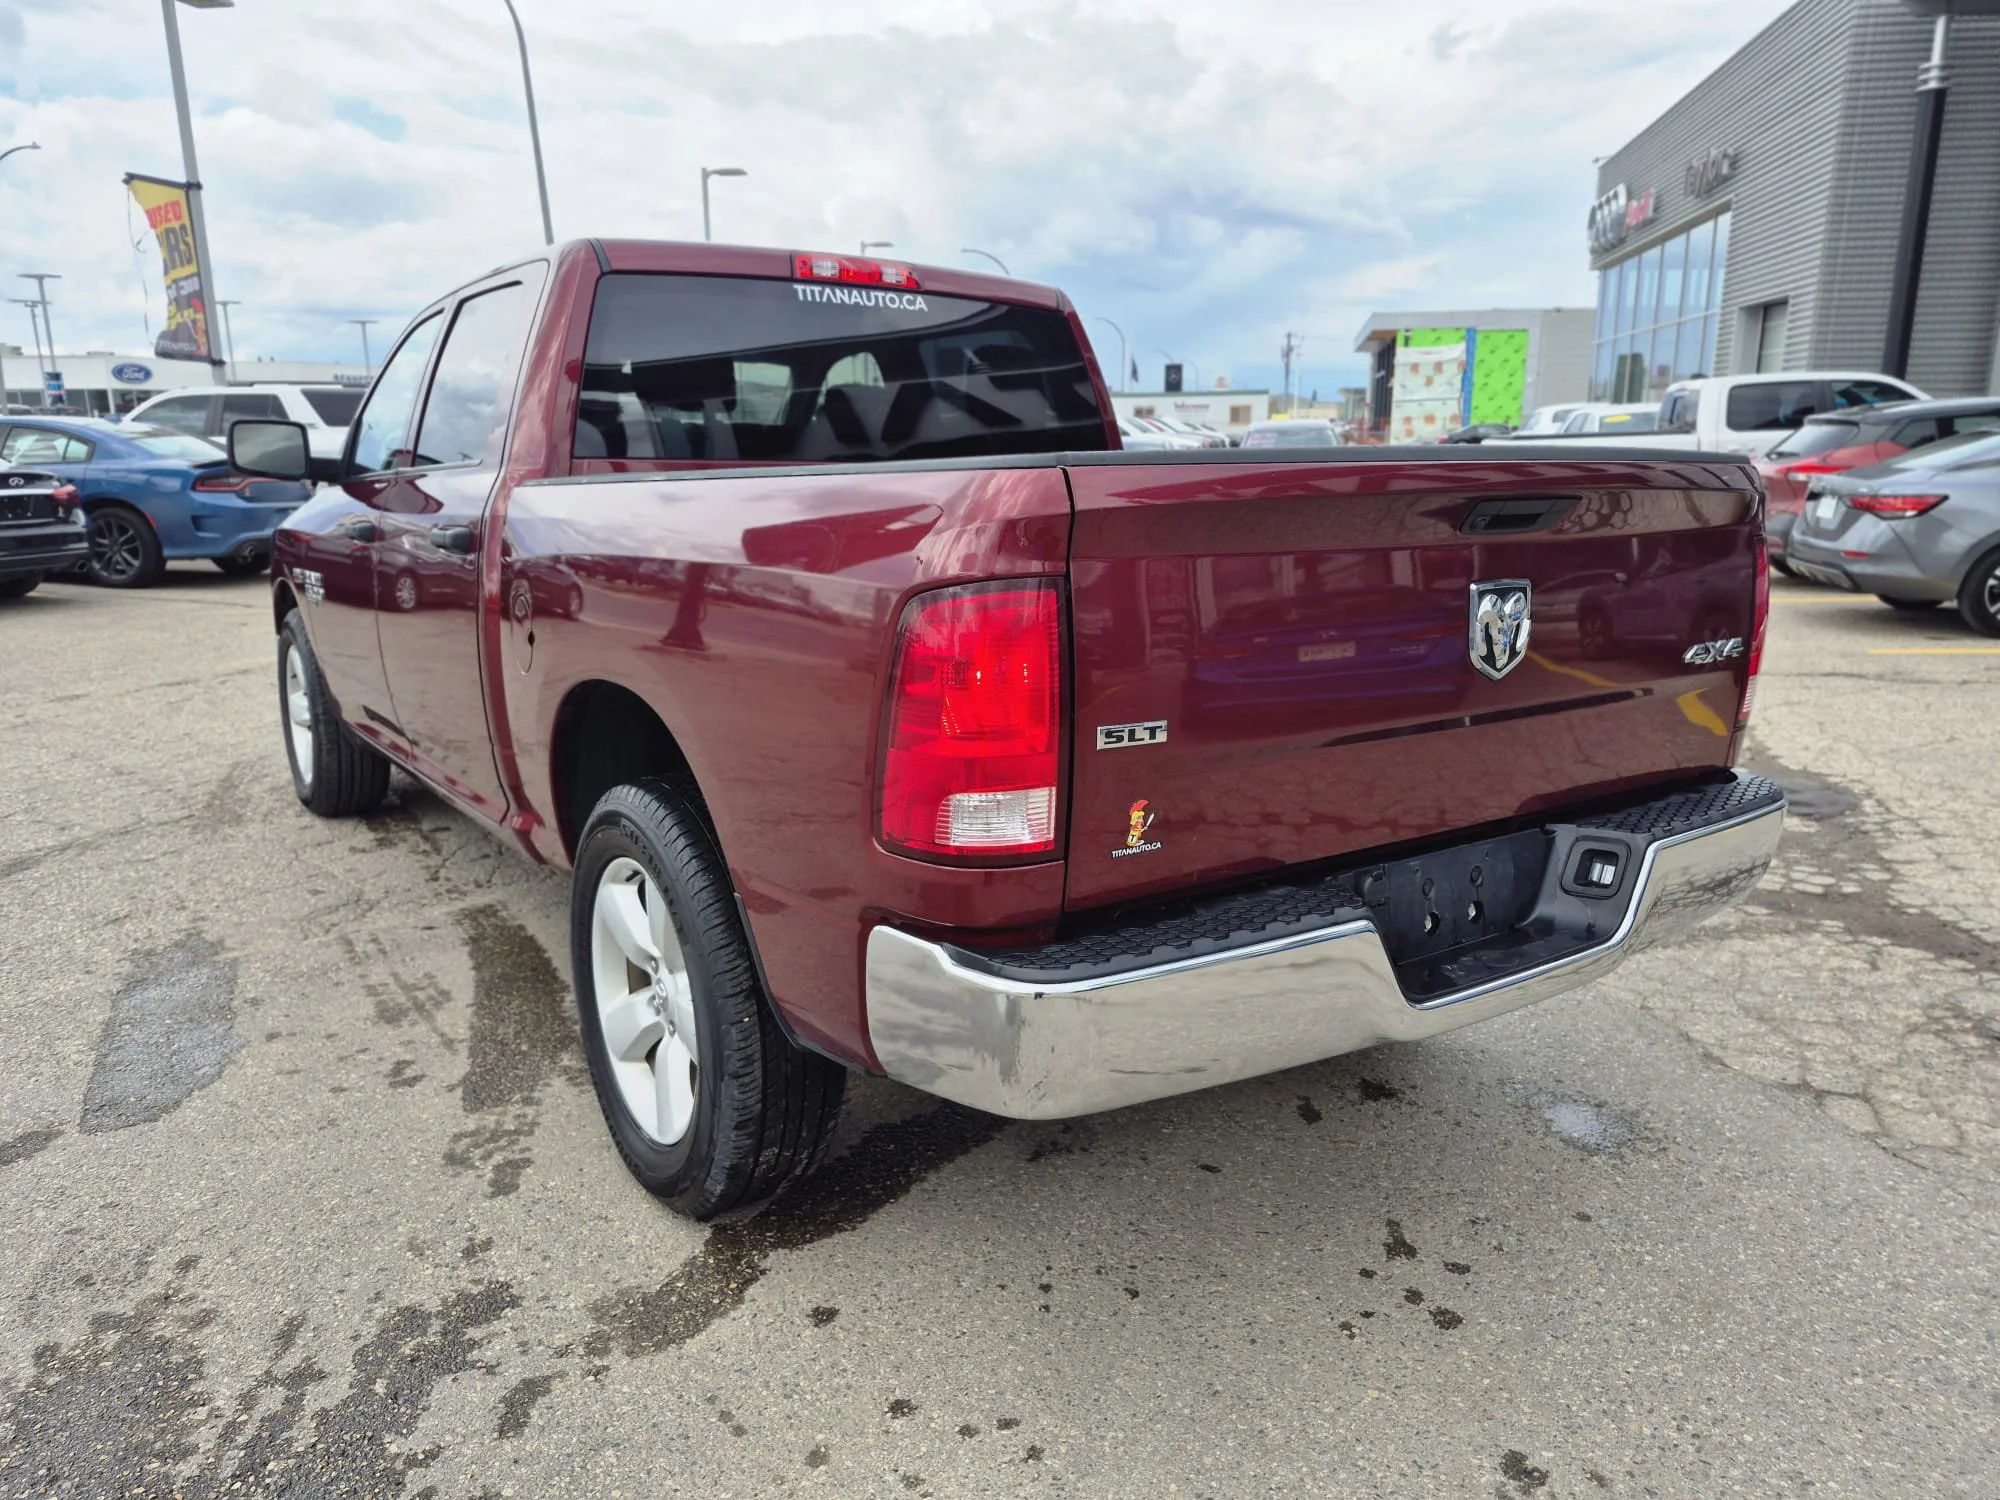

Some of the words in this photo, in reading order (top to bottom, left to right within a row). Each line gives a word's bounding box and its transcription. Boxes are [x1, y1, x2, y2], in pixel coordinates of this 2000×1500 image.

[793, 284, 929, 312] TITANAUTO.CA
[1103, 724, 1163, 745] SLT
[1111, 841, 1162, 858] TITANAUTO.CA
